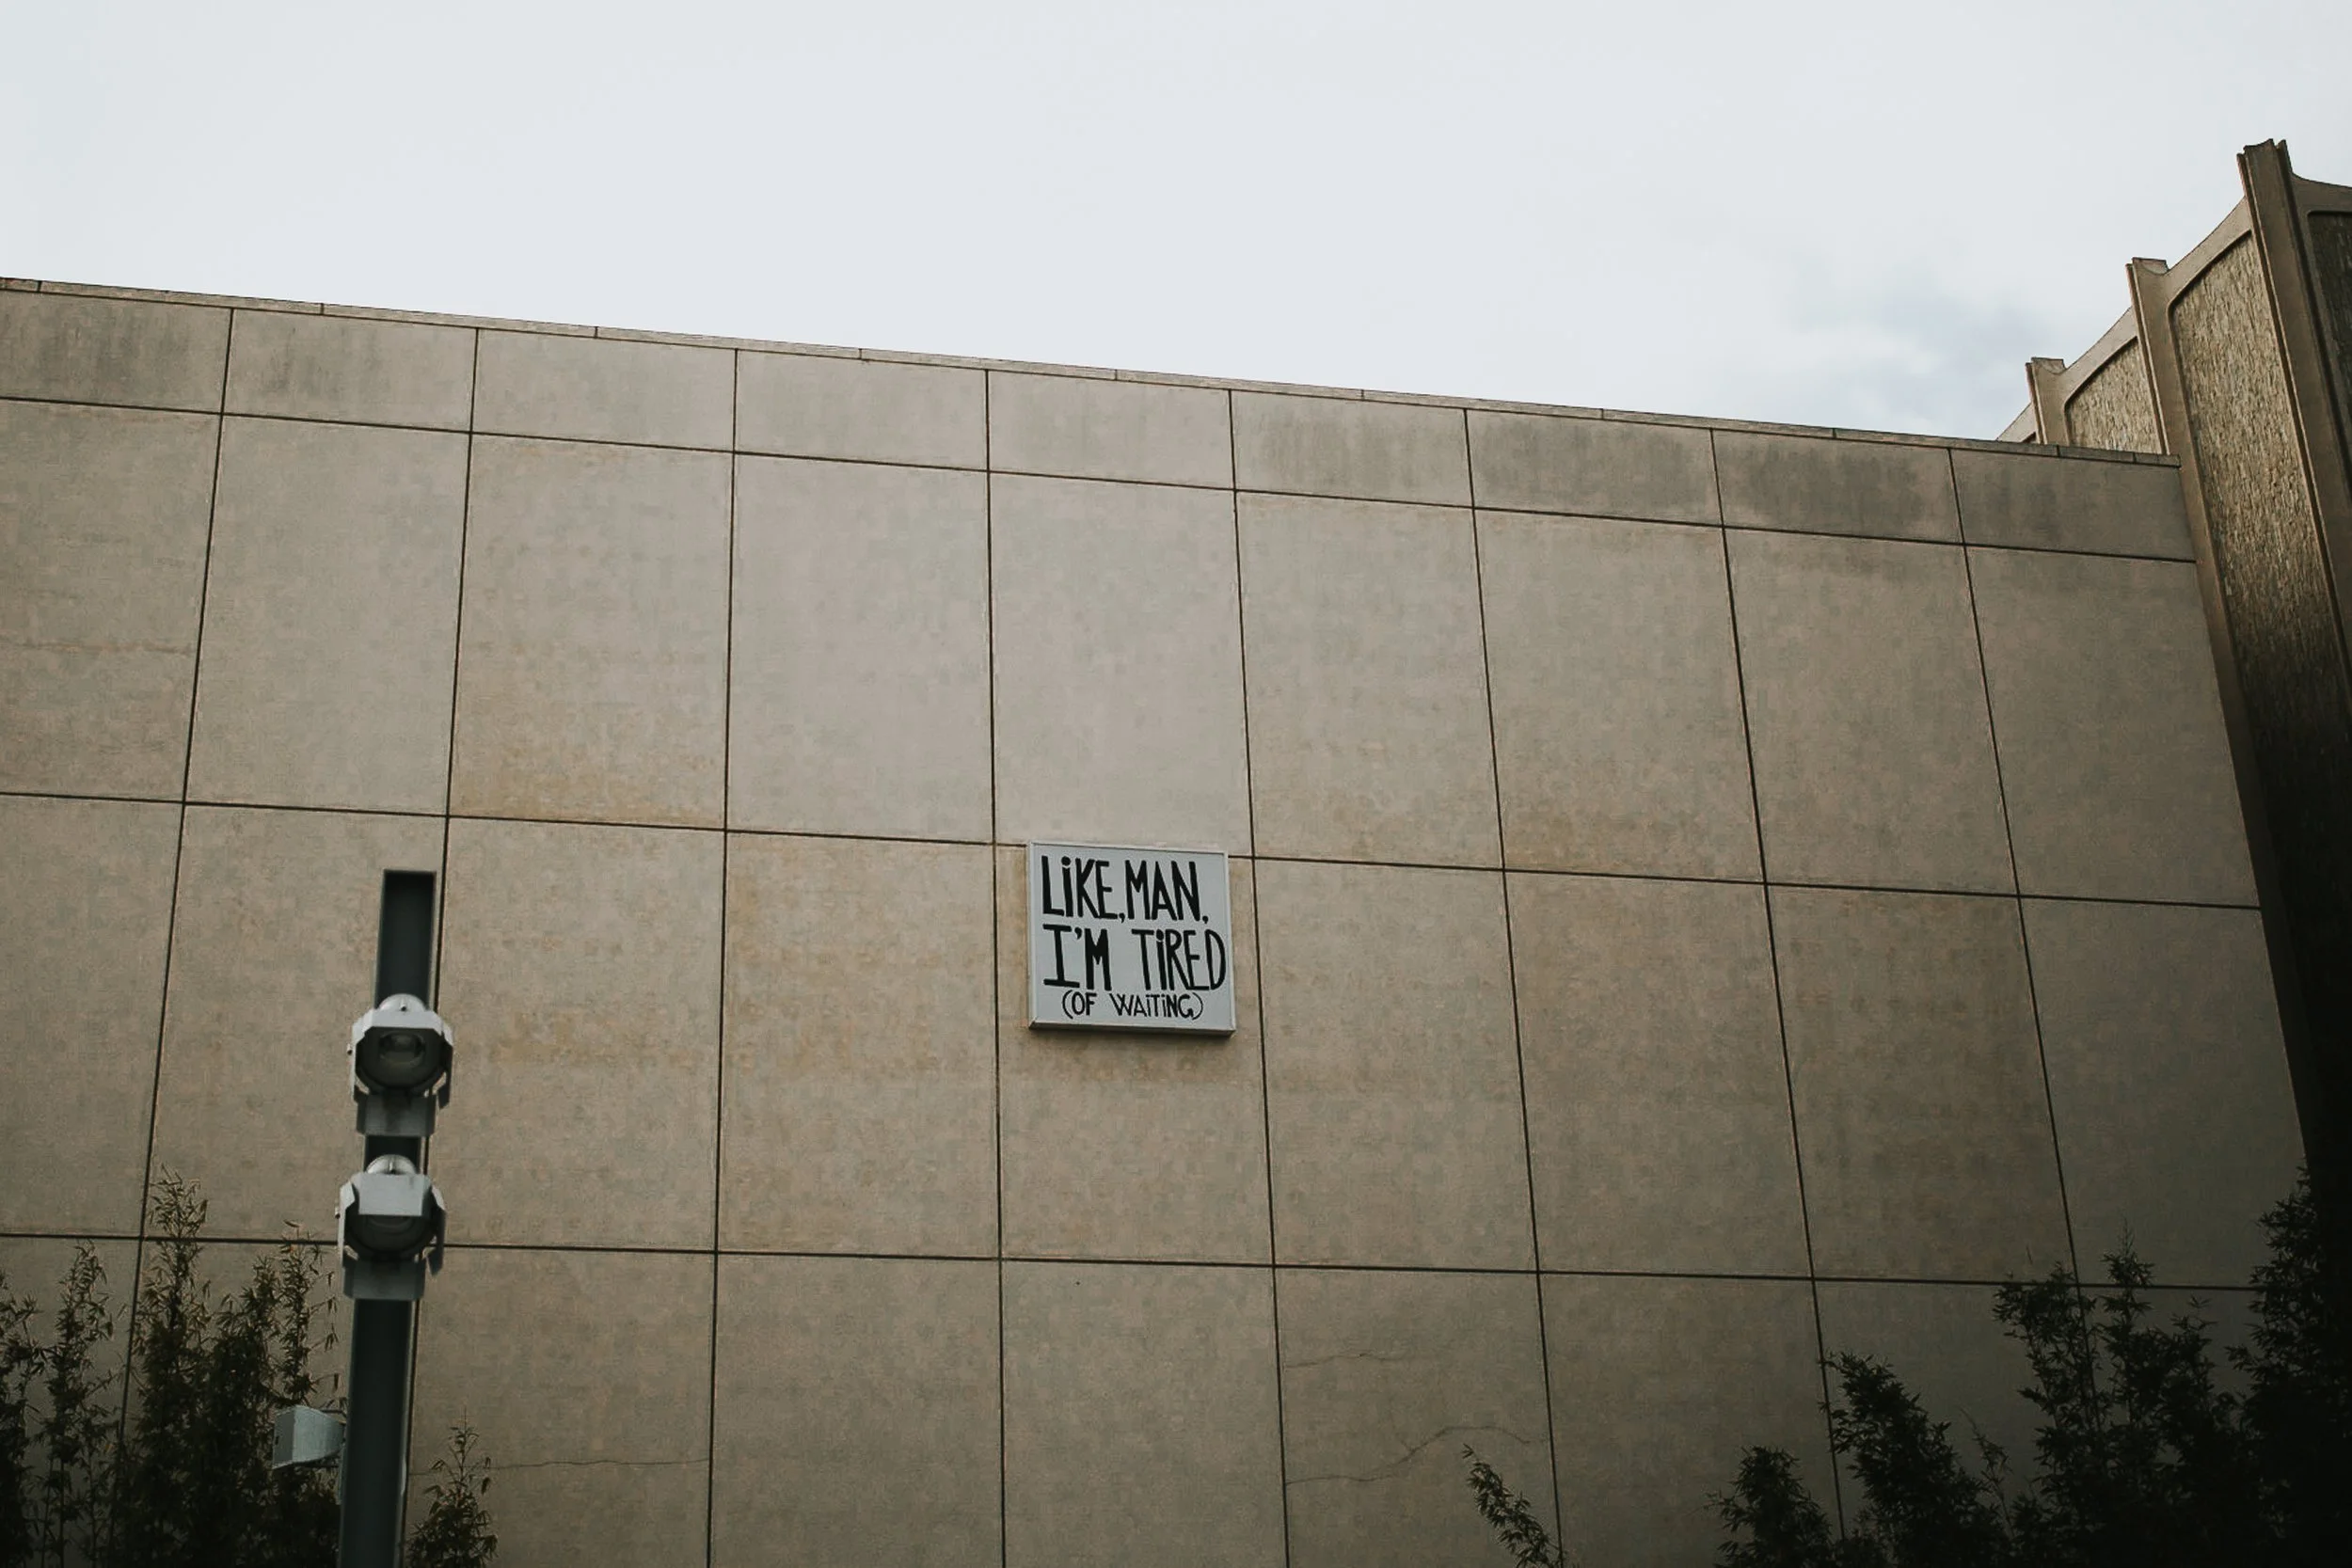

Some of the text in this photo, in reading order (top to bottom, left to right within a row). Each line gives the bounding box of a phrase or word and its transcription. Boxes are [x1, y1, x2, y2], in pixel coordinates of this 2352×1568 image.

[1125, 860, 1209, 924] MAN,
[1042, 924, 1112, 990] I'M
[1062, 990, 1097, 1019] (OF
